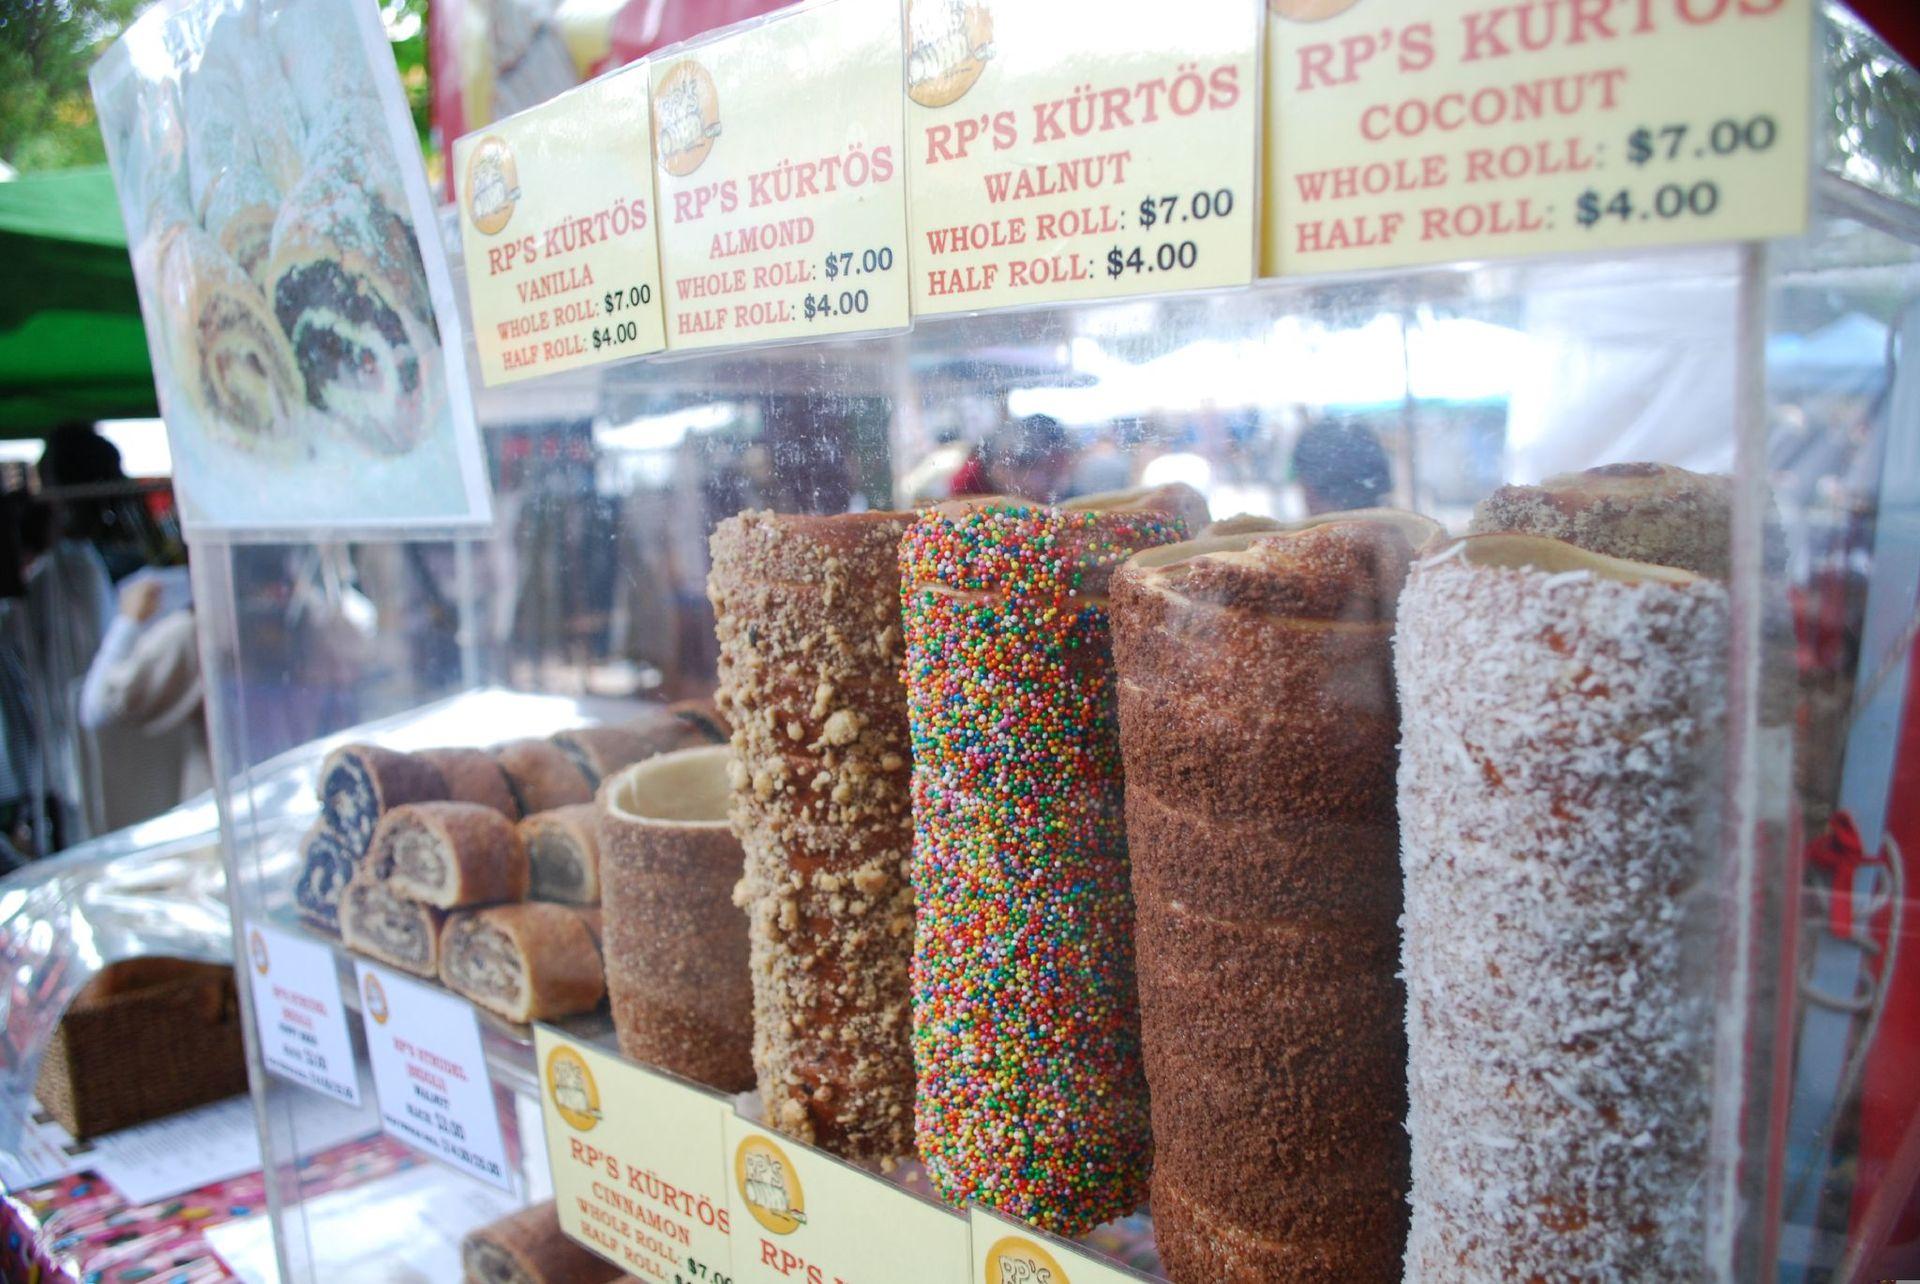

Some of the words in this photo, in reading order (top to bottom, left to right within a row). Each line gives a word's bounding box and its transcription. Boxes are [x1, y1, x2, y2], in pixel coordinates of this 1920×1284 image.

[1295, 22, 1437, 92] RP'S
[925, 110, 1018, 164] RP'S
[1032, 64, 1241, 145] KÜRTÖS
[1360, 67, 1627, 143] COCONUT
[673, 181, 739, 224] RP'S
[747, 142, 895, 210] KÜRTÖS
[985, 150, 1131, 204] WALNUT
[1294, 155, 1448, 203] WHOLE
[1464, 136, 1607, 184] ROLL:
[1627, 114, 1778, 167] $7.00
[488, 236, 537, 276] RP'S
[544, 198, 648, 260] KÜRTÖS
[709, 215, 816, 260] ALMOND
[926, 216, 1026, 256] WHOLE
[1035, 205, 1127, 242] ROLL:
[1139, 188, 1234, 231] $7.00
[1295, 213, 1405, 254] HALF
[1420, 199, 1555, 241] ROLL:
[1575, 181, 1718, 229] $4.00
[517, 263, 595, 303] VANILLA
[677, 267, 746, 301] WHOLE
[752, 259, 817, 289] ROLL:
[825, 247, 894, 281] $7.00
[928, 263, 999, 297] HALF
[1008, 253, 1095, 287] ROLL:
[1106, 241, 1198, 280] $4.00
[497, 309, 549, 341] WHOLE
[554, 300, 600, 326] ROLL:
[605, 284, 651, 314] $7.00
[678, 309, 728, 335] HALF
[734, 299, 796, 327] ROLL:
[804, 289, 869, 321] $4.00
[503, 344, 539, 371] HALF
[542, 334, 588, 364] ROLL:
[592, 320, 637, 350] $4.00
[570, 1136, 620, 1180] RP'S
[627, 1164, 731, 1236] KÜRTÖS
[592, 1181, 691, 1247] CINNAMON
[576, 1195, 631, 1238] WHOLE
[580, 1220, 619, 1251] HALF
[760, 1238, 823, 1284] RP'S
